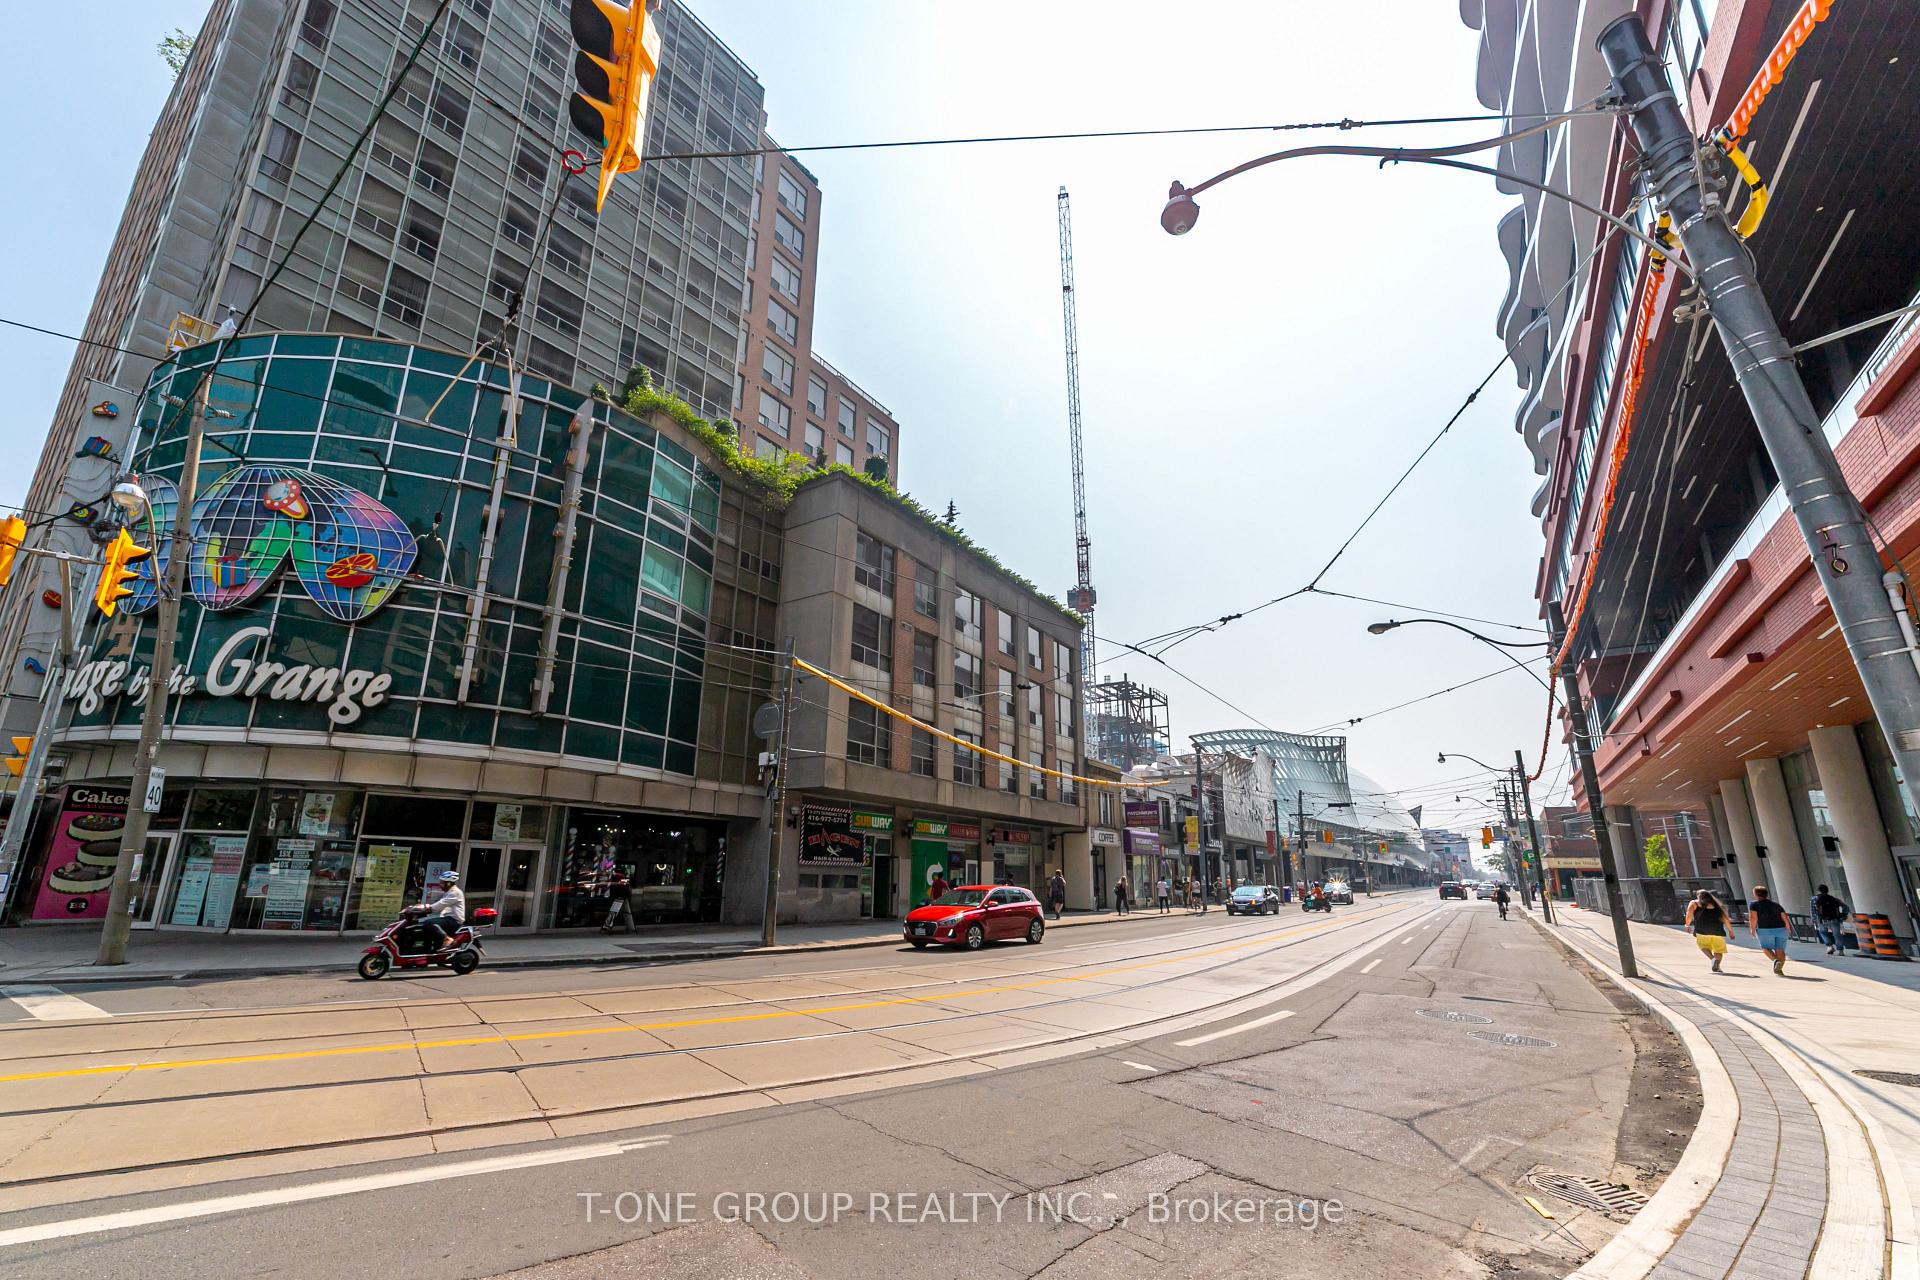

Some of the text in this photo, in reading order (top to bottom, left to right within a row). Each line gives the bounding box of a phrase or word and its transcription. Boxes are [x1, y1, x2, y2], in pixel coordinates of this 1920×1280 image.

[167, 664, 197, 696] he
[205, 626, 392, 725] Grange
[72, 789, 131, 805] Cakes
[148, 785, 162, 806] 40
[855, 815, 893, 829] SUBWAY
[915, 822, 948, 835] SUBWAY
[1098, 833, 1114, 843] COFFEE
